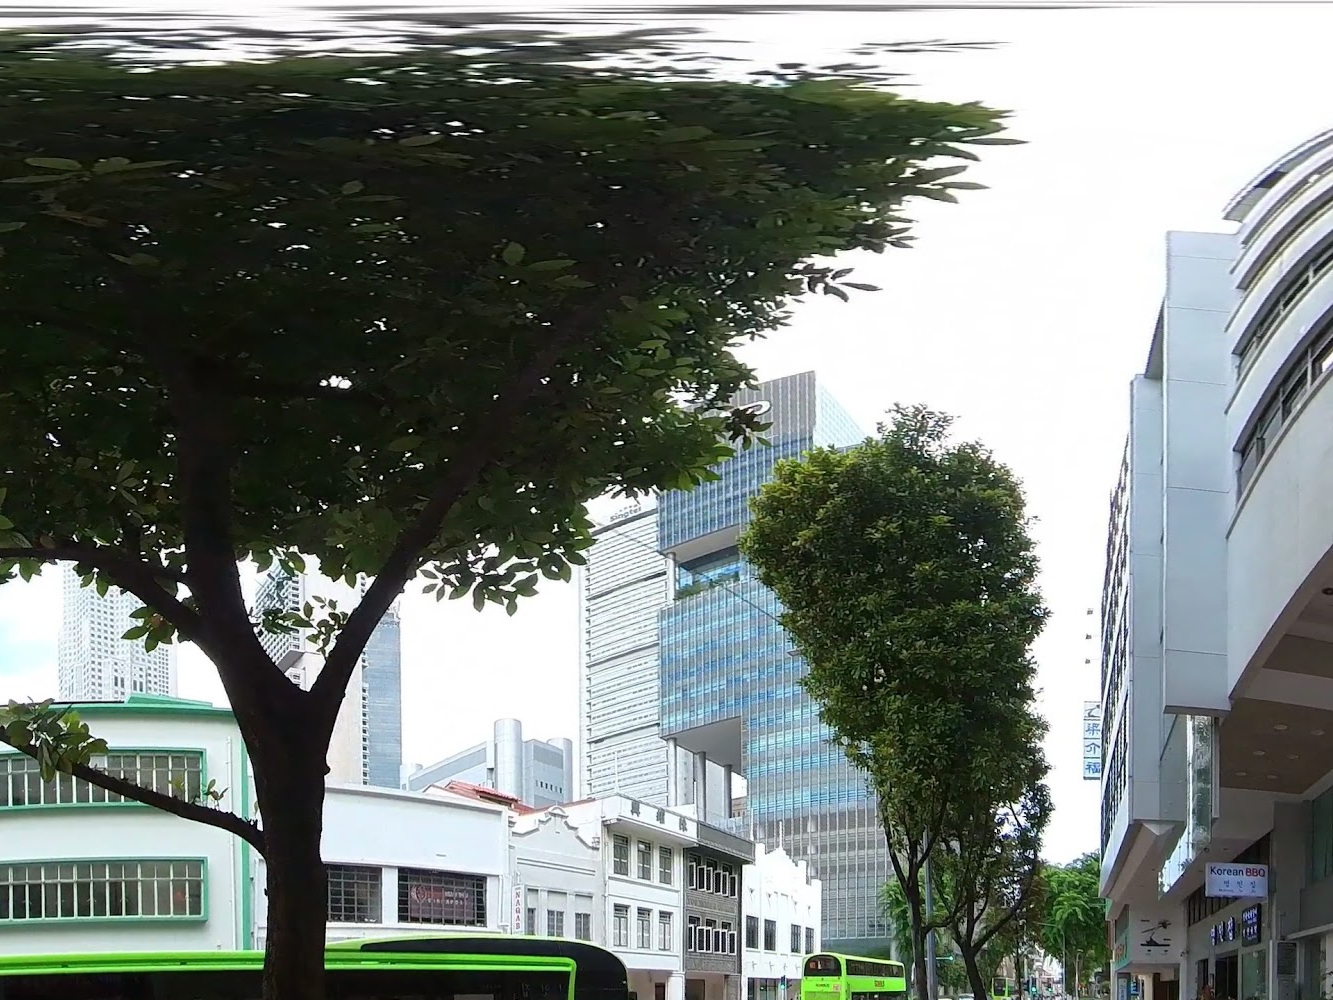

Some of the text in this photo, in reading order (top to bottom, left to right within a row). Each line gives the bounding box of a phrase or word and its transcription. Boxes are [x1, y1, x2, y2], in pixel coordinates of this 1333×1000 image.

[610, 507, 642, 522] Singtel
[1210, 866, 1266, 878] Korean BBQ
